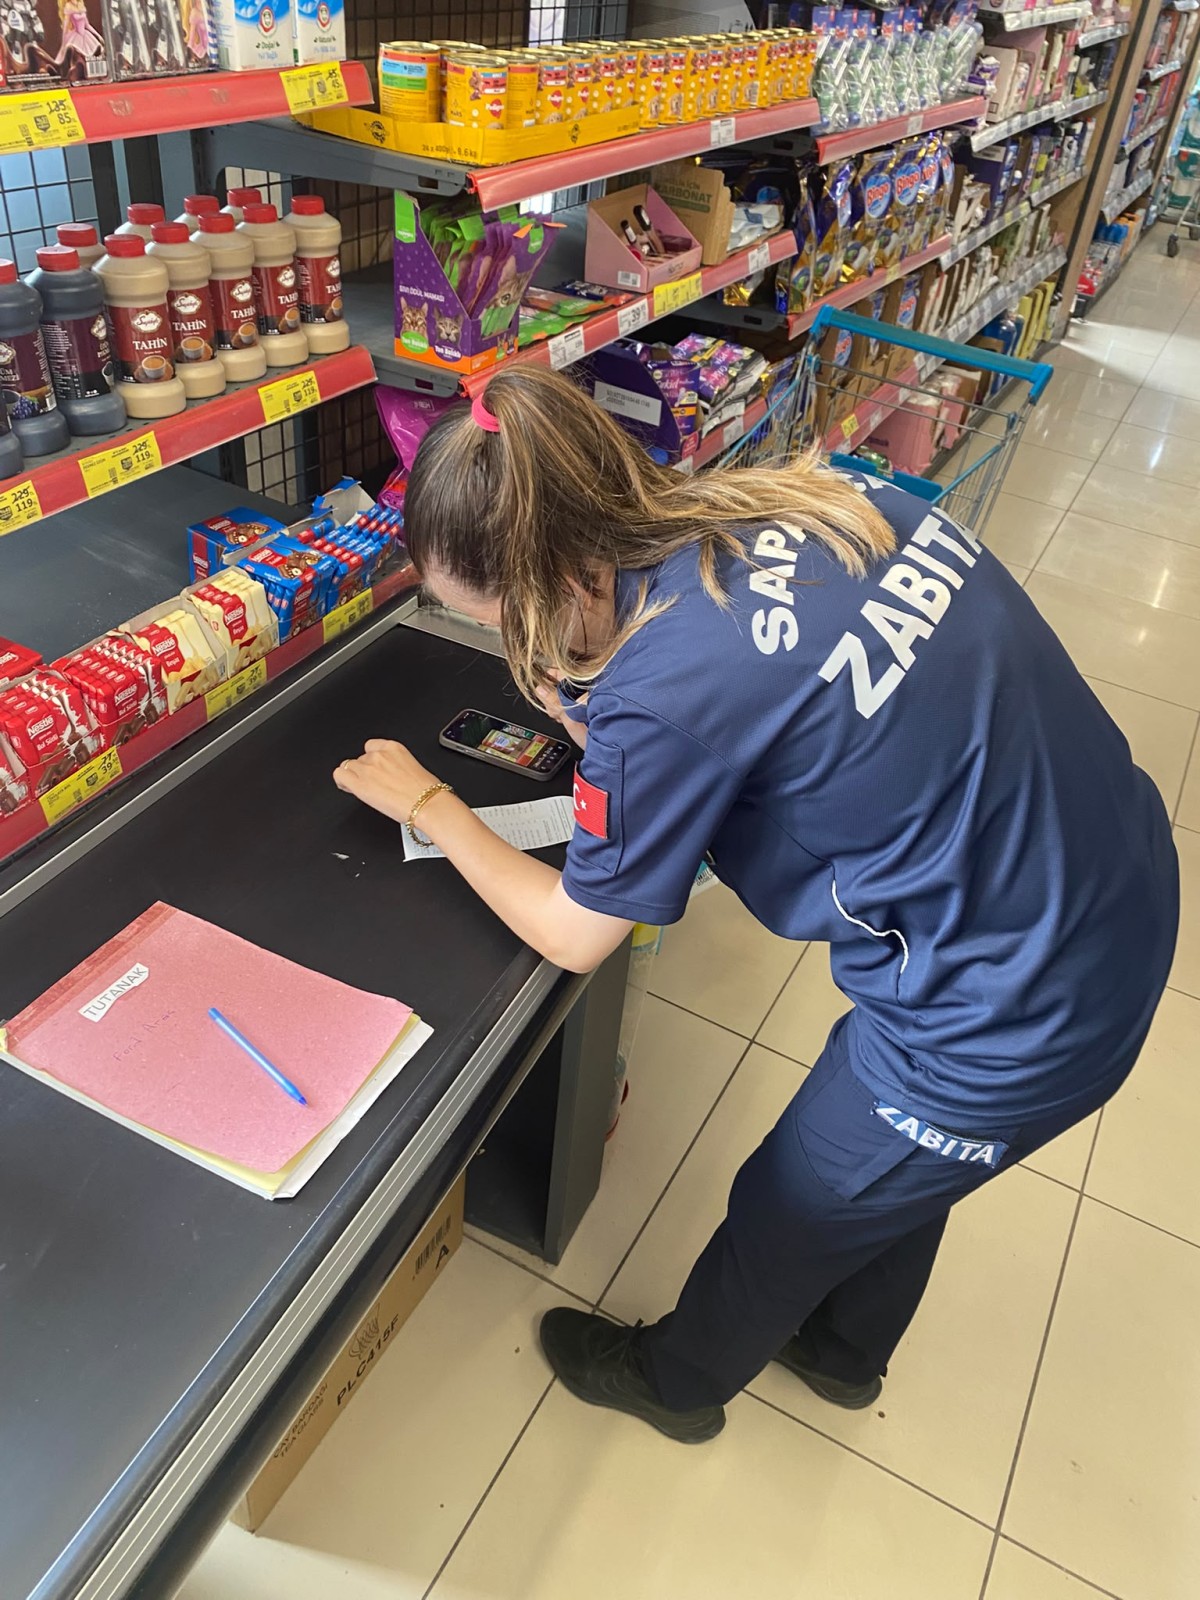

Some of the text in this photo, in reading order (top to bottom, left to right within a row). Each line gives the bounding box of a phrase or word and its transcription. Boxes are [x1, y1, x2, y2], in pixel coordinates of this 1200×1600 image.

[58, 112, 72, 125] 85
[895, 171, 920, 195] Bingo
[866, 182, 890, 207] Bingo
[172, 319, 207, 331] TAHİN
[132, 337, 168, 350] TAHİN
[135, 450, 150, 463] 119
[16, 498, 33, 512] 119
[27, 714, 54, 739] Nestlé
[101, 762, 113, 775] 39
[82, 967, 148, 1016] TUTANAK
[875, 1106, 995, 1165] ZABITA
